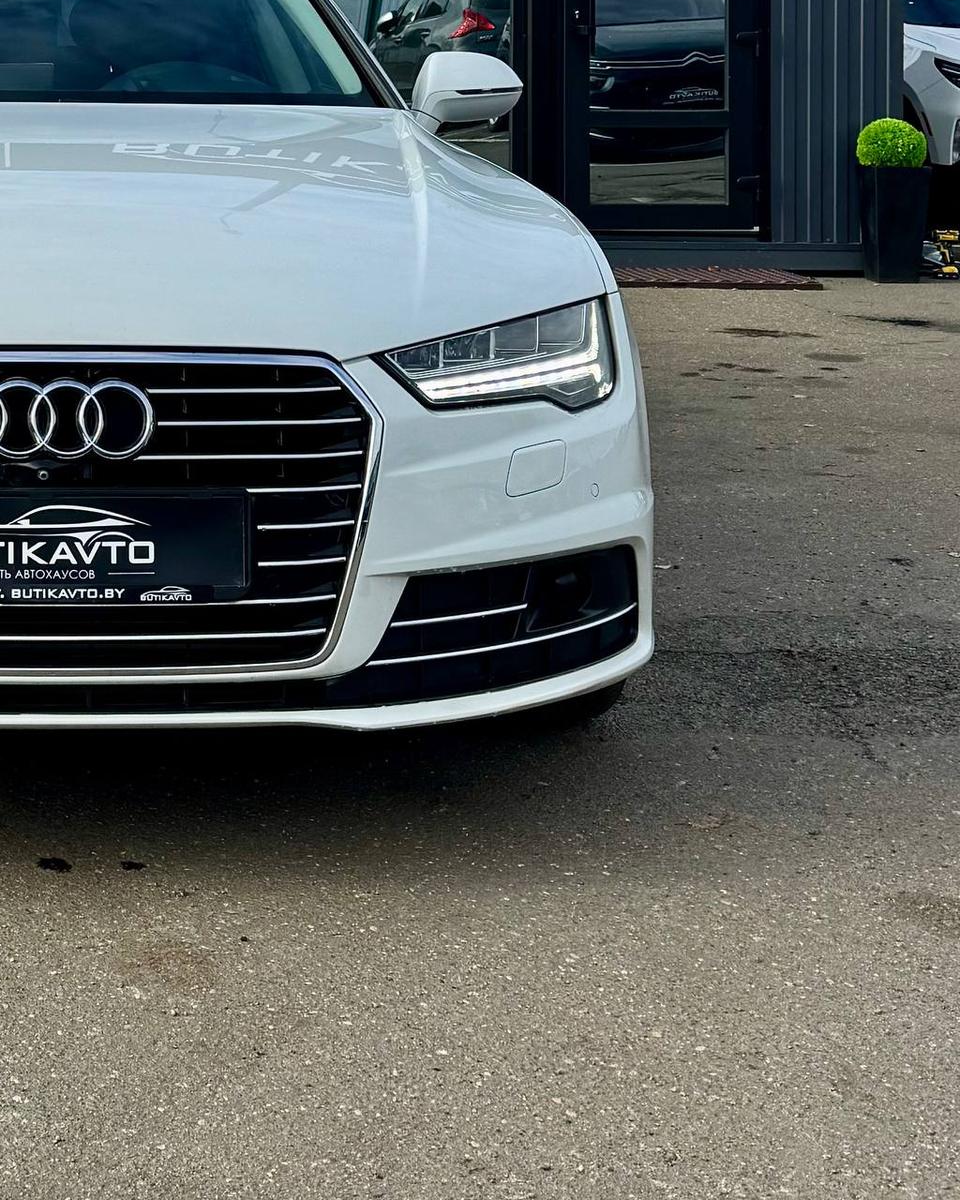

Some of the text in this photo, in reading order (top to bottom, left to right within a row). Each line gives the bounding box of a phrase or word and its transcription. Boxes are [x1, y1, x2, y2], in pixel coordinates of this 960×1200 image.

[15, 568, 96, 580] АВТОХАУСОВ
[11, 588, 126, 600] BUTIKAVTO.BY
[140, 593, 192, 602] BUTIKAVTO
